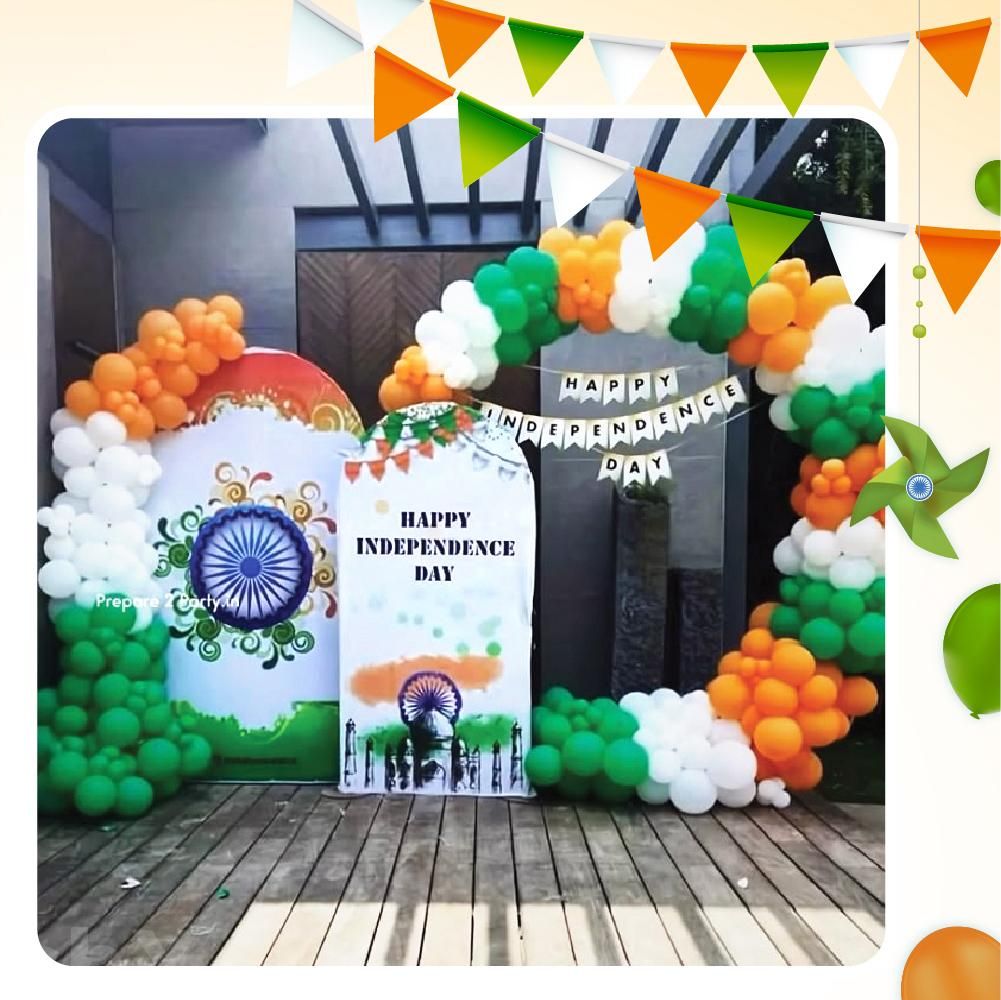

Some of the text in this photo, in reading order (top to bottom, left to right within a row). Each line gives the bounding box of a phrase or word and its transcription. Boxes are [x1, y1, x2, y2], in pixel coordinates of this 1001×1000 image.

[566, 374, 670, 393] HAPPY
[487, 384, 736, 437] INDEPENDENCE
[606, 457, 663, 474] DAY
[401, 511, 471, 529] HAPPY
[356, 537, 516, 557] INDEPENDENCE
[415, 565, 455, 582] DAY
